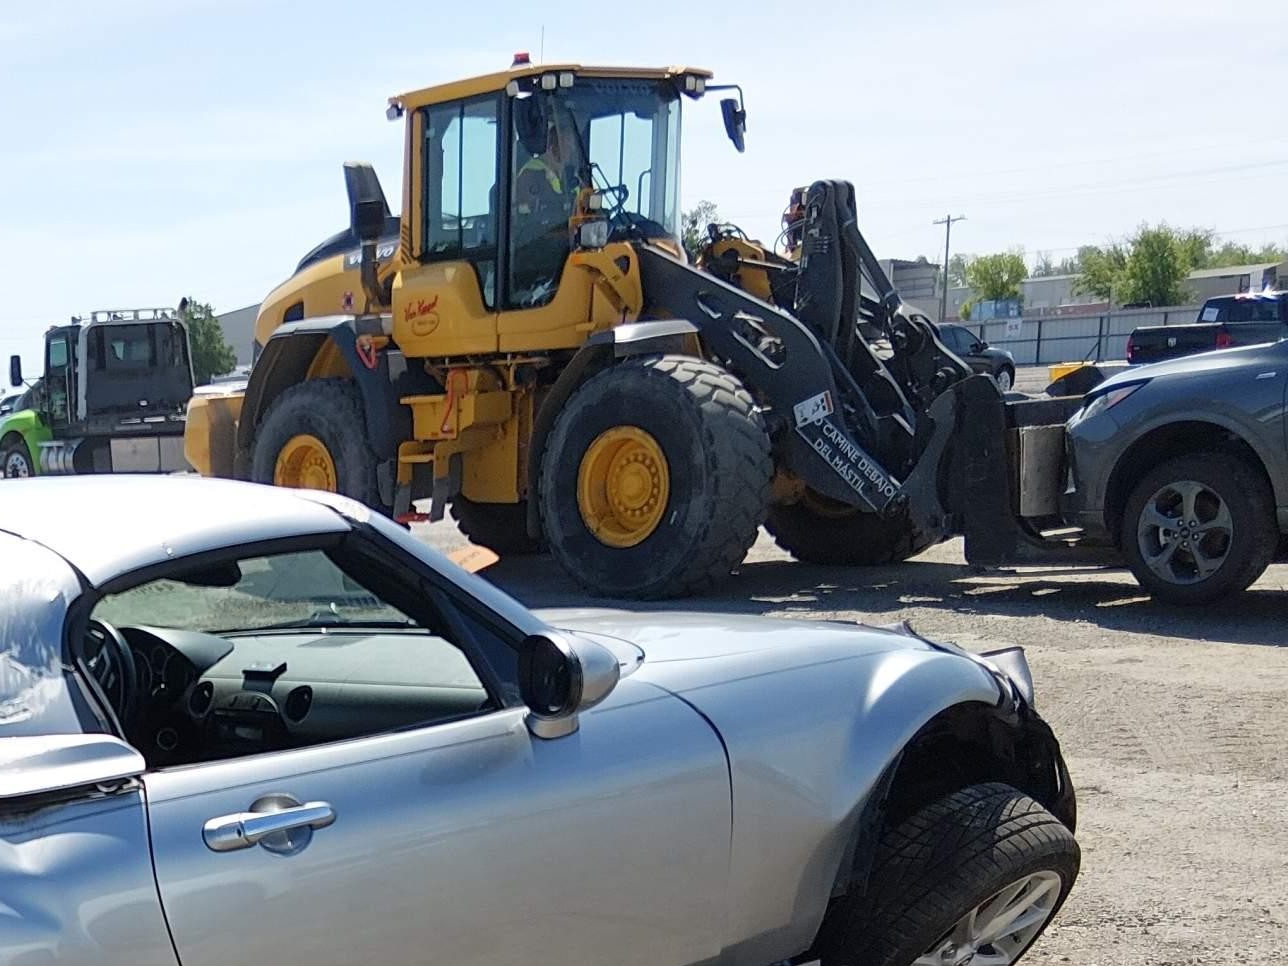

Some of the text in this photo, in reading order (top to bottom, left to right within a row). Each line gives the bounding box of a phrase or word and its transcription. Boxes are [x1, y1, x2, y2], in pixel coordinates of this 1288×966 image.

[349, 246, 394, 264] VVO
[814, 438, 865, 493] DEL MÁSTIL
[823, 424, 860, 463] CAMINE
[857, 458, 895, 497] DEBAJO
